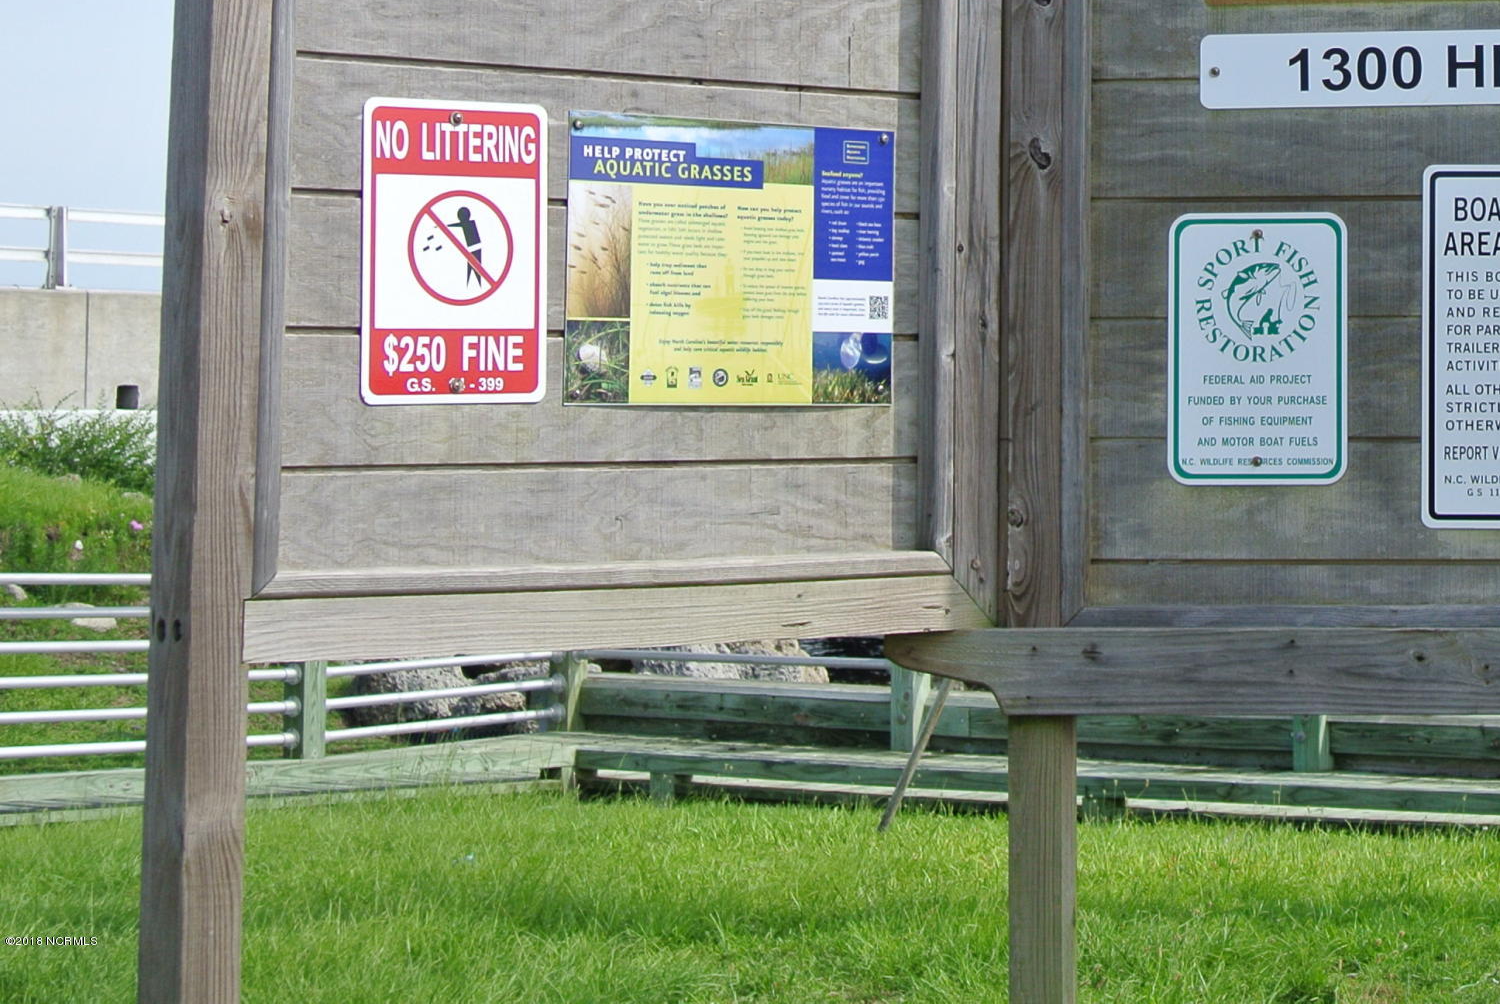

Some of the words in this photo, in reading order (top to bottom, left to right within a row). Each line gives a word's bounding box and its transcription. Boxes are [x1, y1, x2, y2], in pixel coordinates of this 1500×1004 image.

[1288, 45, 1423, 92] 1300
[376, 120, 409, 160] NO
[422, 122, 536, 164] LITTERING
[583, 145, 620, 158] HELP
[625, 148, 686, 162] PROTECT
[593, 159, 671, 178] AQUATIC
[678, 164, 753, 182] GRASSES
[1197, 235, 1264, 291] SPORT
[1274, 241, 1319, 289] FISH
[1446, 270, 1479, 283] THIS
[1446, 288, 1464, 300] TO
[1468, 288, 1485, 301] BE
[1446, 306, 1476, 318] AND
[1195, 295, 1320, 363] RESTORATION
[1446, 324, 1472, 336] FOR
[383, 333, 446, 376] $250
[462, 335, 524, 372] FINE
[406, 378, 436, 392] G.S.
[478, 377, 504, 391] 399
[1203, 374, 1246, 385] FEDERAL
[1249, 374, 1266, 385] AID
[1269, 374, 1313, 385] PROJECT
[1445, 383, 1470, 396] ALL
[1187, 395, 1225, 406] FUNDED
[1229, 395, 1242, 406] BY
[1246, 395, 1273, 406] YOUR
[1277, 395, 1328, 406] PURCHASE
[1201, 416, 1215, 427] OF
[1218, 415, 1256, 427] FISHING
[1260, 415, 1313, 427] EQUIPMENT
[1196, 436, 1217, 447] AND
[1221, 436, 1255, 447] MOTOR
[1259, 436, 1285, 447] BOAT
[1288, 436, 1319, 447] FUELS
[1443, 445, 1489, 461] REPORT
[1181, 457, 1195, 466] N.C.
[1199, 457, 1233, 466] WILDLIFE
[1237, 457, 1283, 466] RESRCES
[1286, 457, 1334, 466] COMMISSION
[1444, 474, 1467, 485] N.C.
